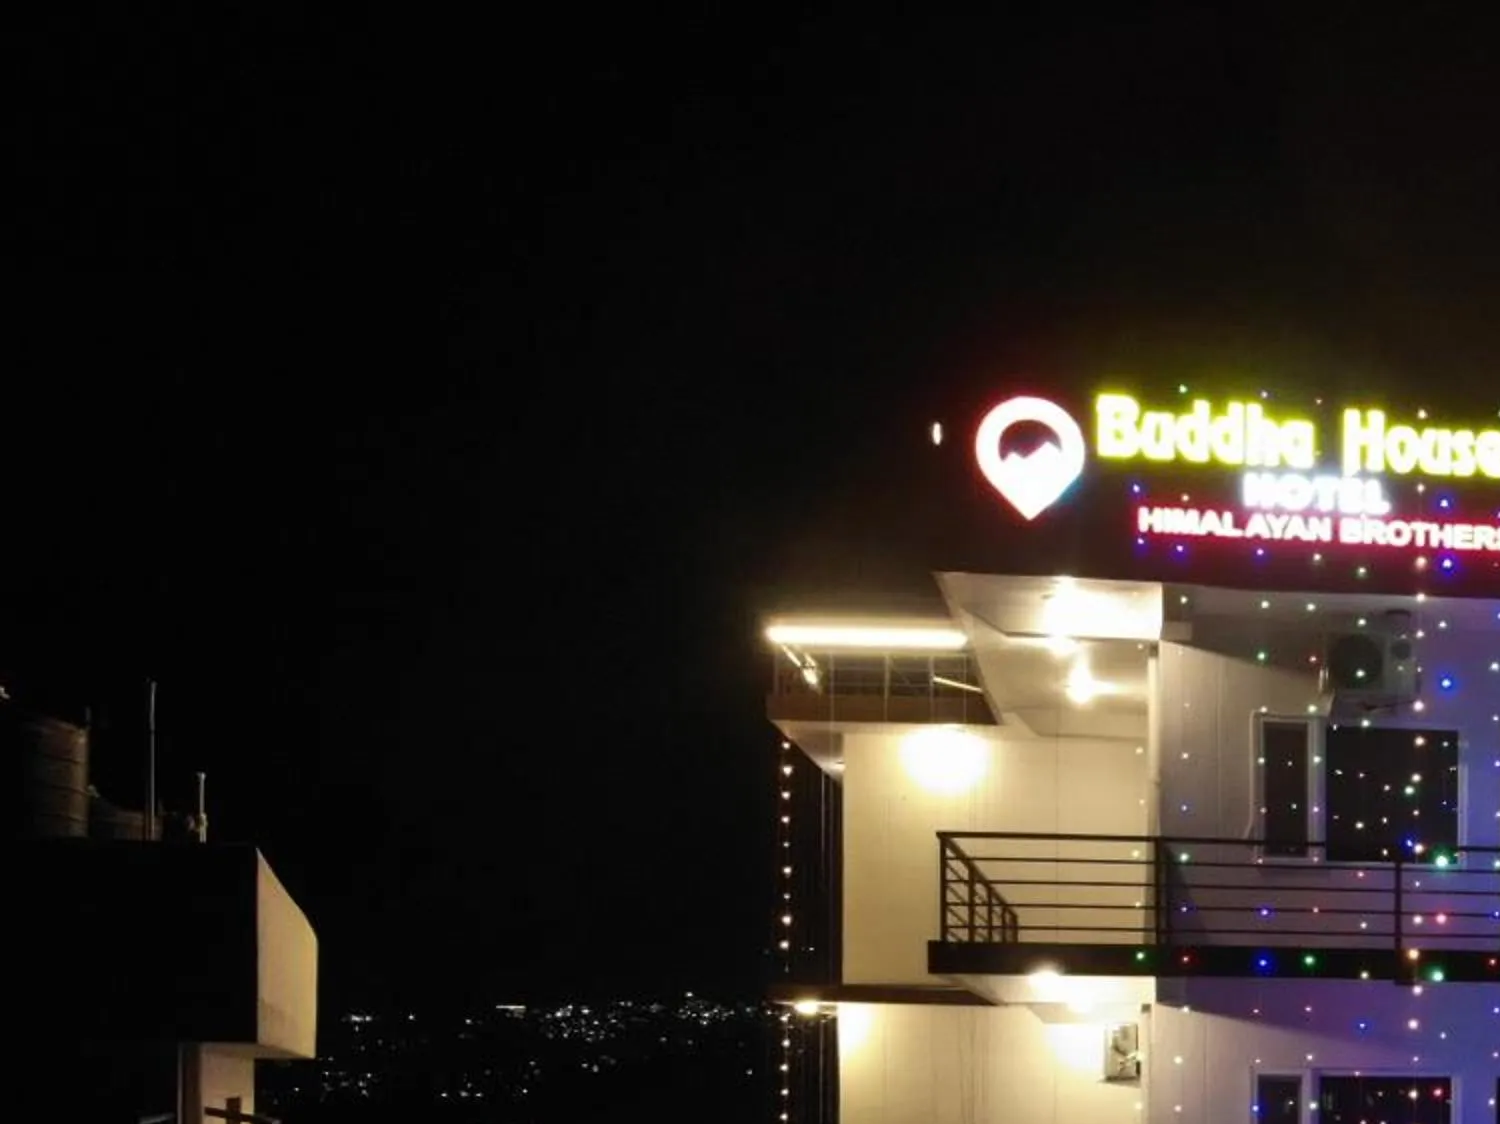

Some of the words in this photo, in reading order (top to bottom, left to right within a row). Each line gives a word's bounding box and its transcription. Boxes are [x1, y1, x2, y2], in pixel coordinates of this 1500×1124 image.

[1096, 393, 1316, 468] Buddha
[1243, 472, 1391, 515] HOTEL
[1137, 506, 1332, 542] HIMALAYAN
